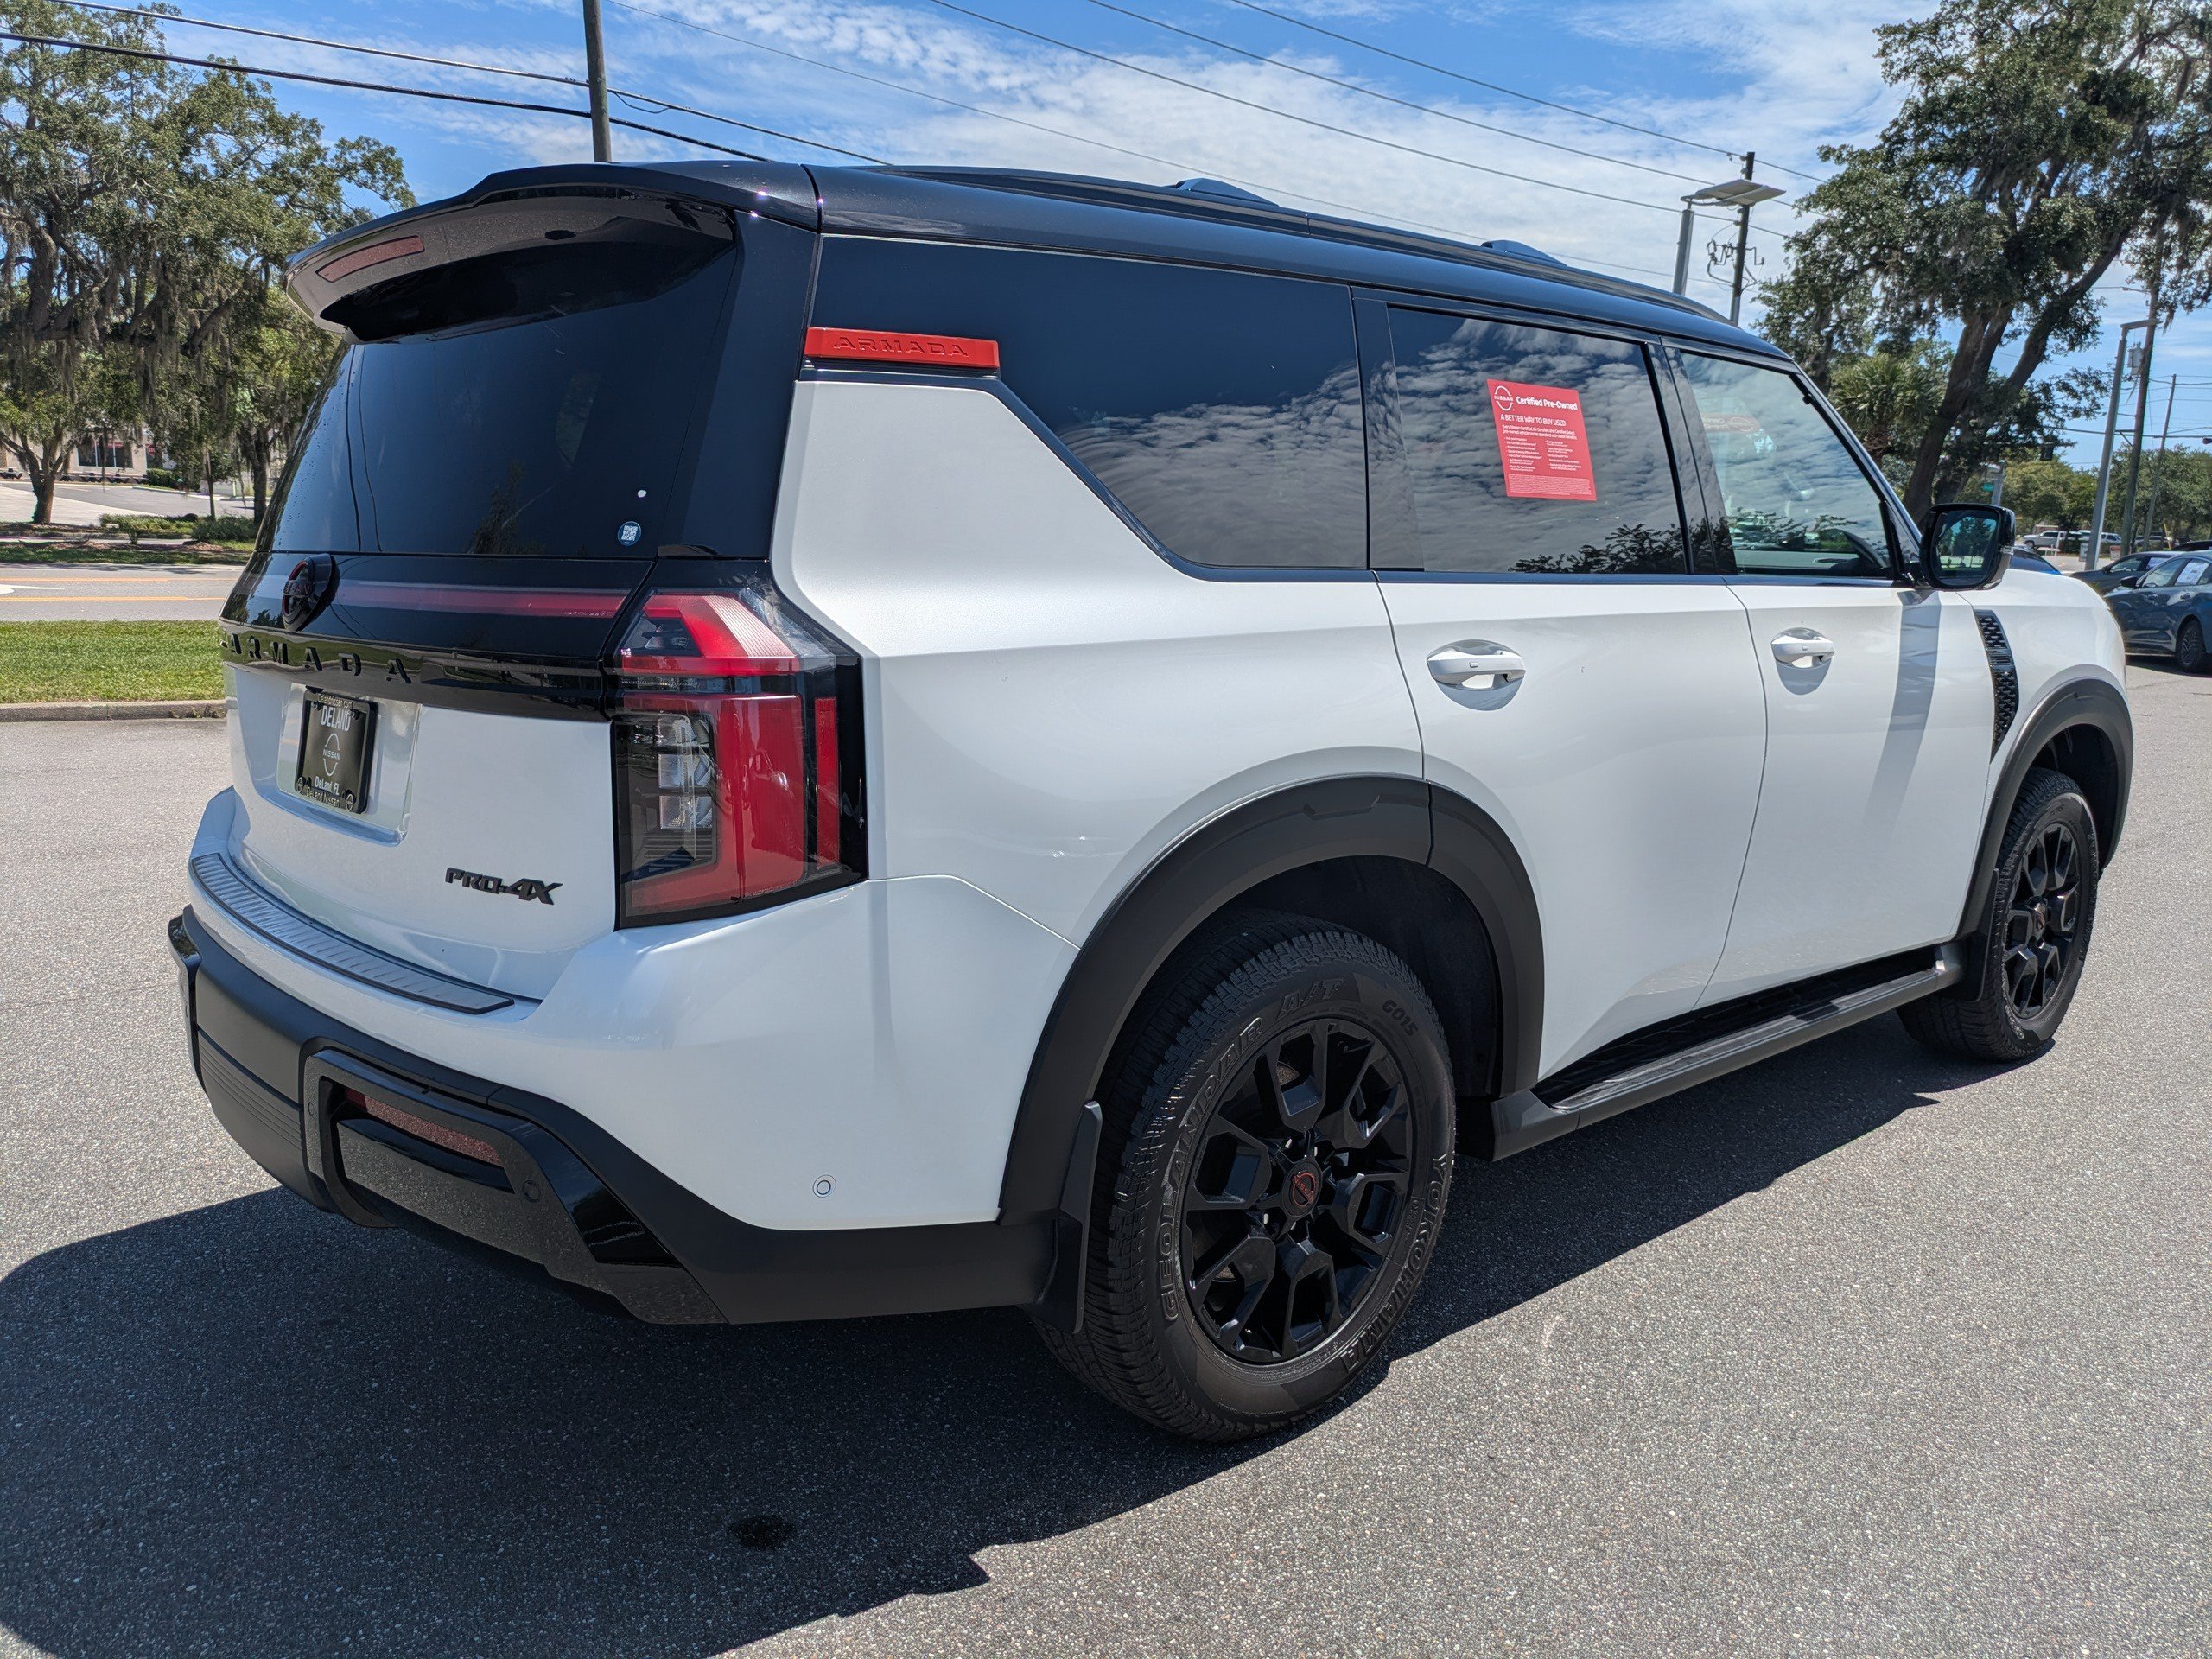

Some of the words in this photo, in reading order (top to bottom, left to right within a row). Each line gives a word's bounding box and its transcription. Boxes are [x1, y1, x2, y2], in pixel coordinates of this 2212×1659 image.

[833, 336, 969, 358] ARMADA
[1516, 397, 1543, 407] Certified
[1543, 398, 1578, 410] Pre-Owned
[1505, 414, 1524, 423] BETTER
[1524, 416, 1536, 424] WAY
[219, 633, 411, 684] ARMADA
[321, 705, 351, 732] DELAND
[323, 748, 340, 760] NISSAN
[333, 782, 340, 796] FL
[445, 867, 563, 906] PRO-4X
[1276, 977, 1346, 1020] A/T
[1340, 1153, 1448, 1373] YOKOHAMA
